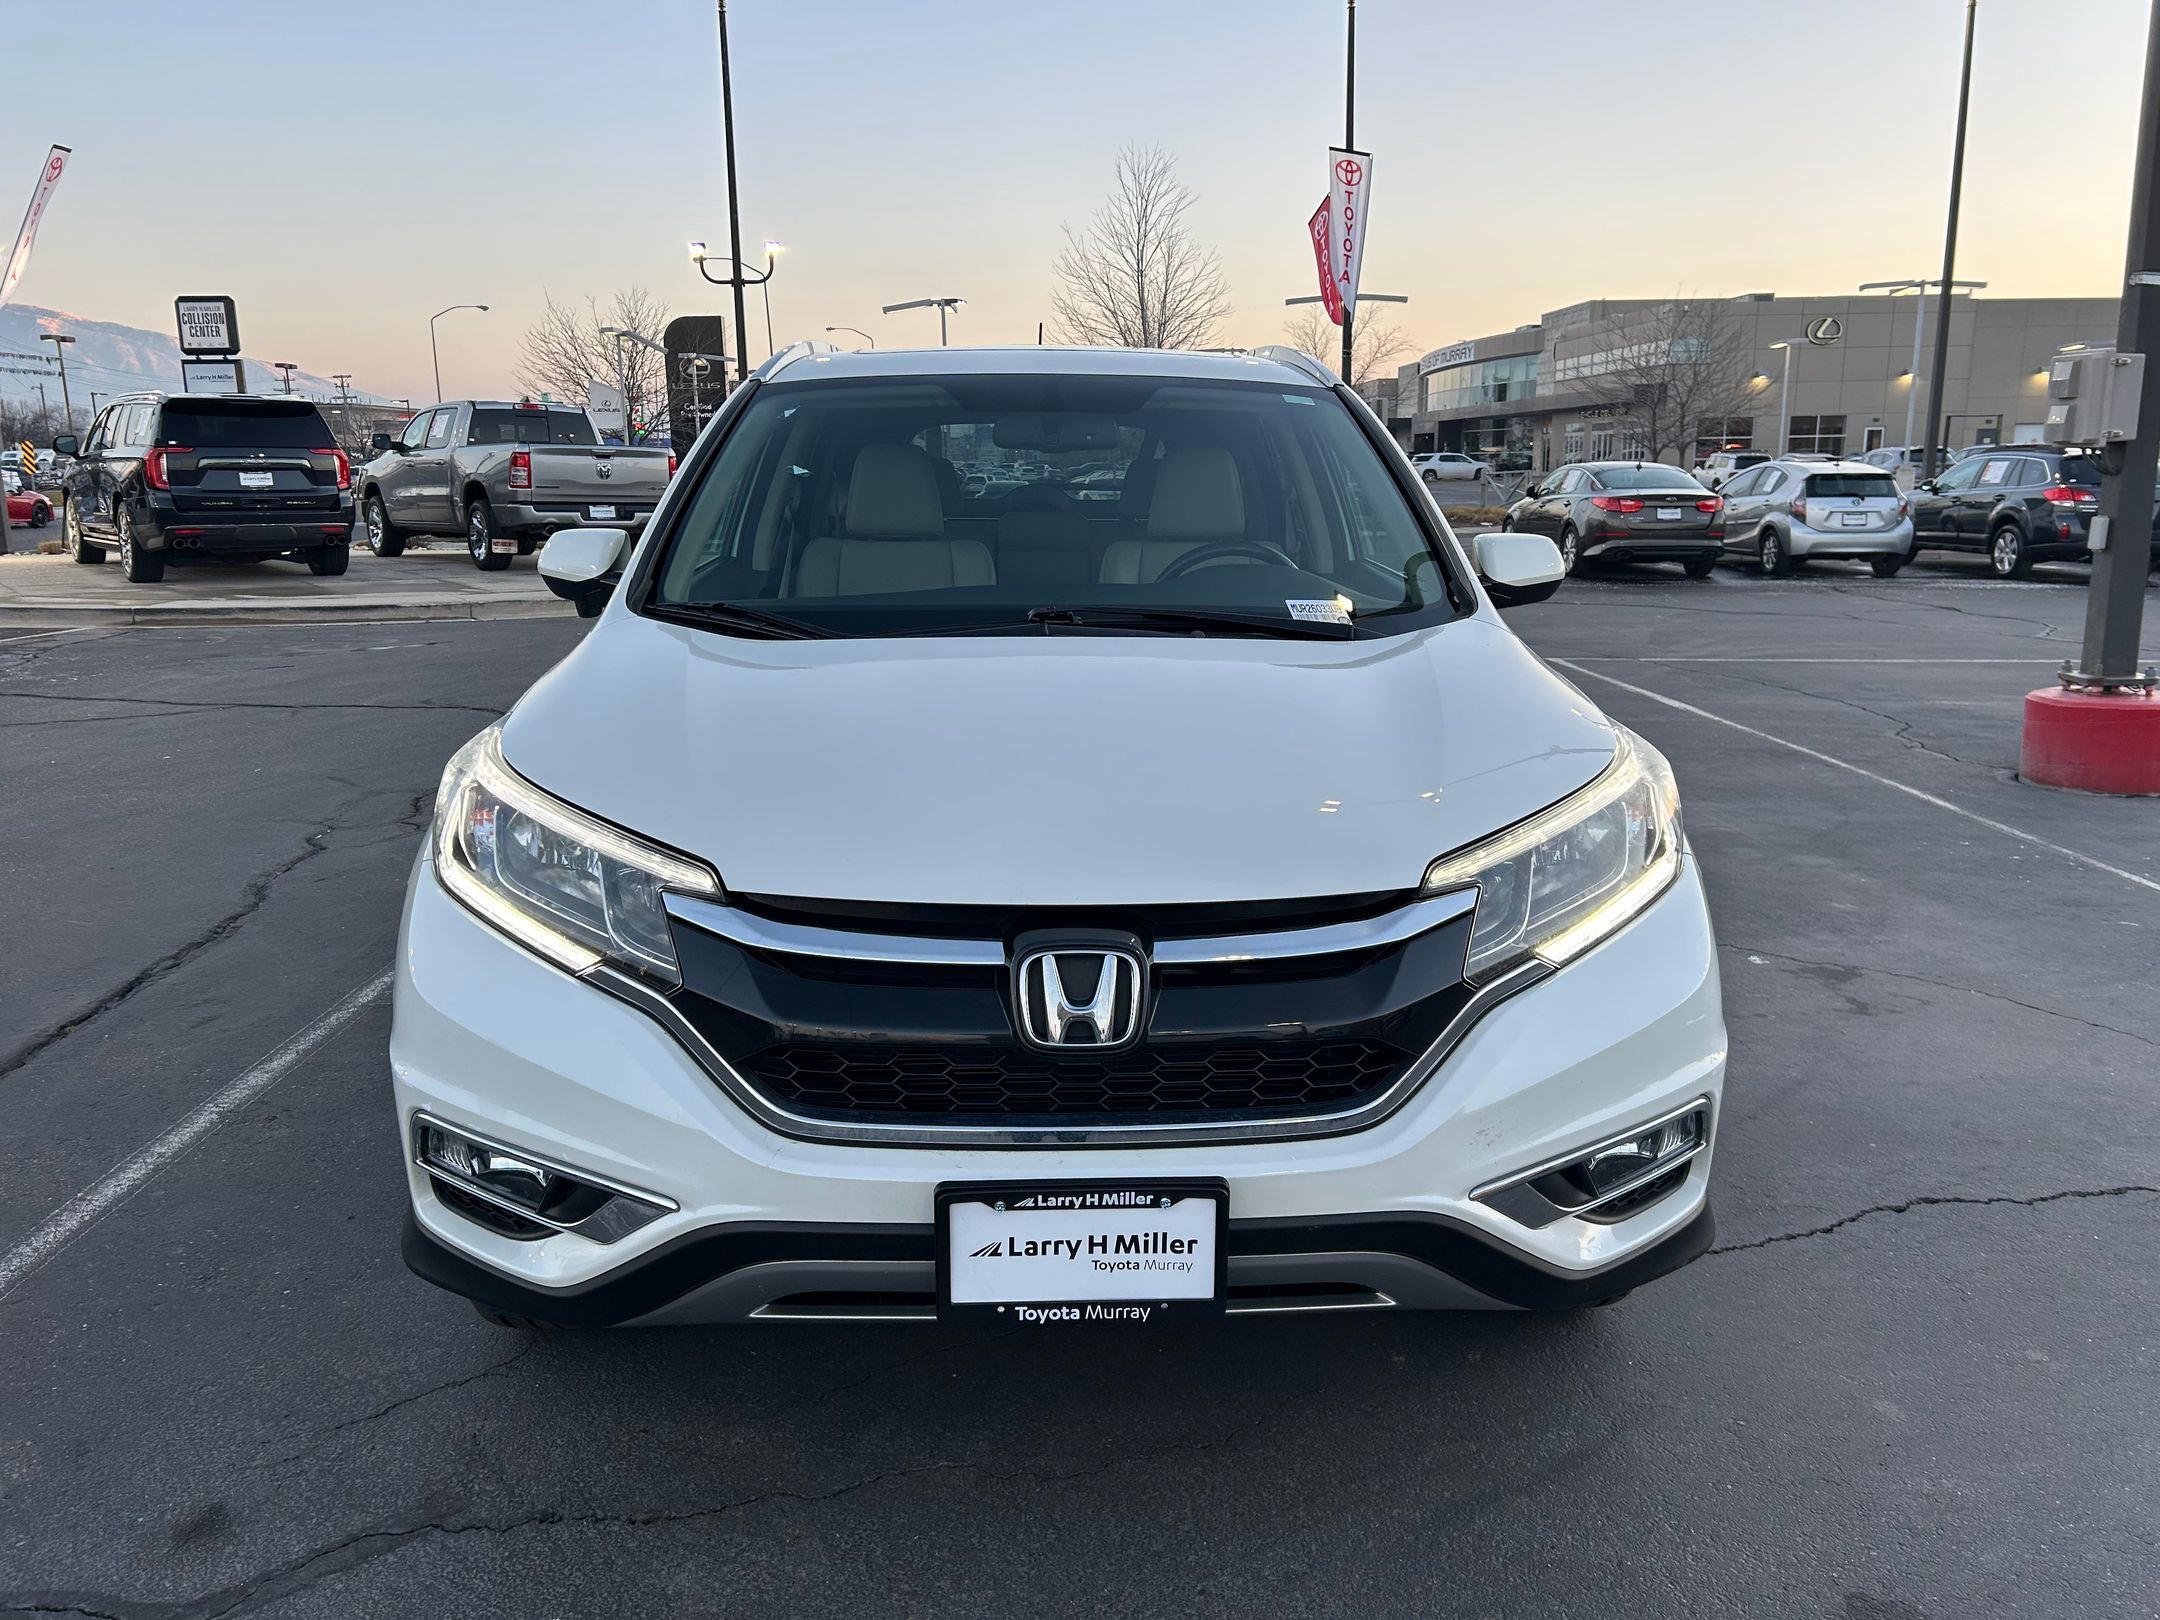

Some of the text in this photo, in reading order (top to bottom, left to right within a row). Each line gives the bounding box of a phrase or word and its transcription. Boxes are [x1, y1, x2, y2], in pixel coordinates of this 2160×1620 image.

[1338, 190, 1354, 285] TOYOTA
[1319, 235, 1335, 316] TOYOTA
[181, 312, 225, 325] COLLISION
[189, 325, 221, 338] CENTER
[1440, 345, 1474, 364] MURRAY
[1037, 1191, 1154, 1209] Larry H Miller
[1008, 1232, 1198, 1260] Larry H Miller
[1092, 1259, 1194, 1273] Toyota Murray
[1015, 1305, 1151, 1324] Toyota Murray
